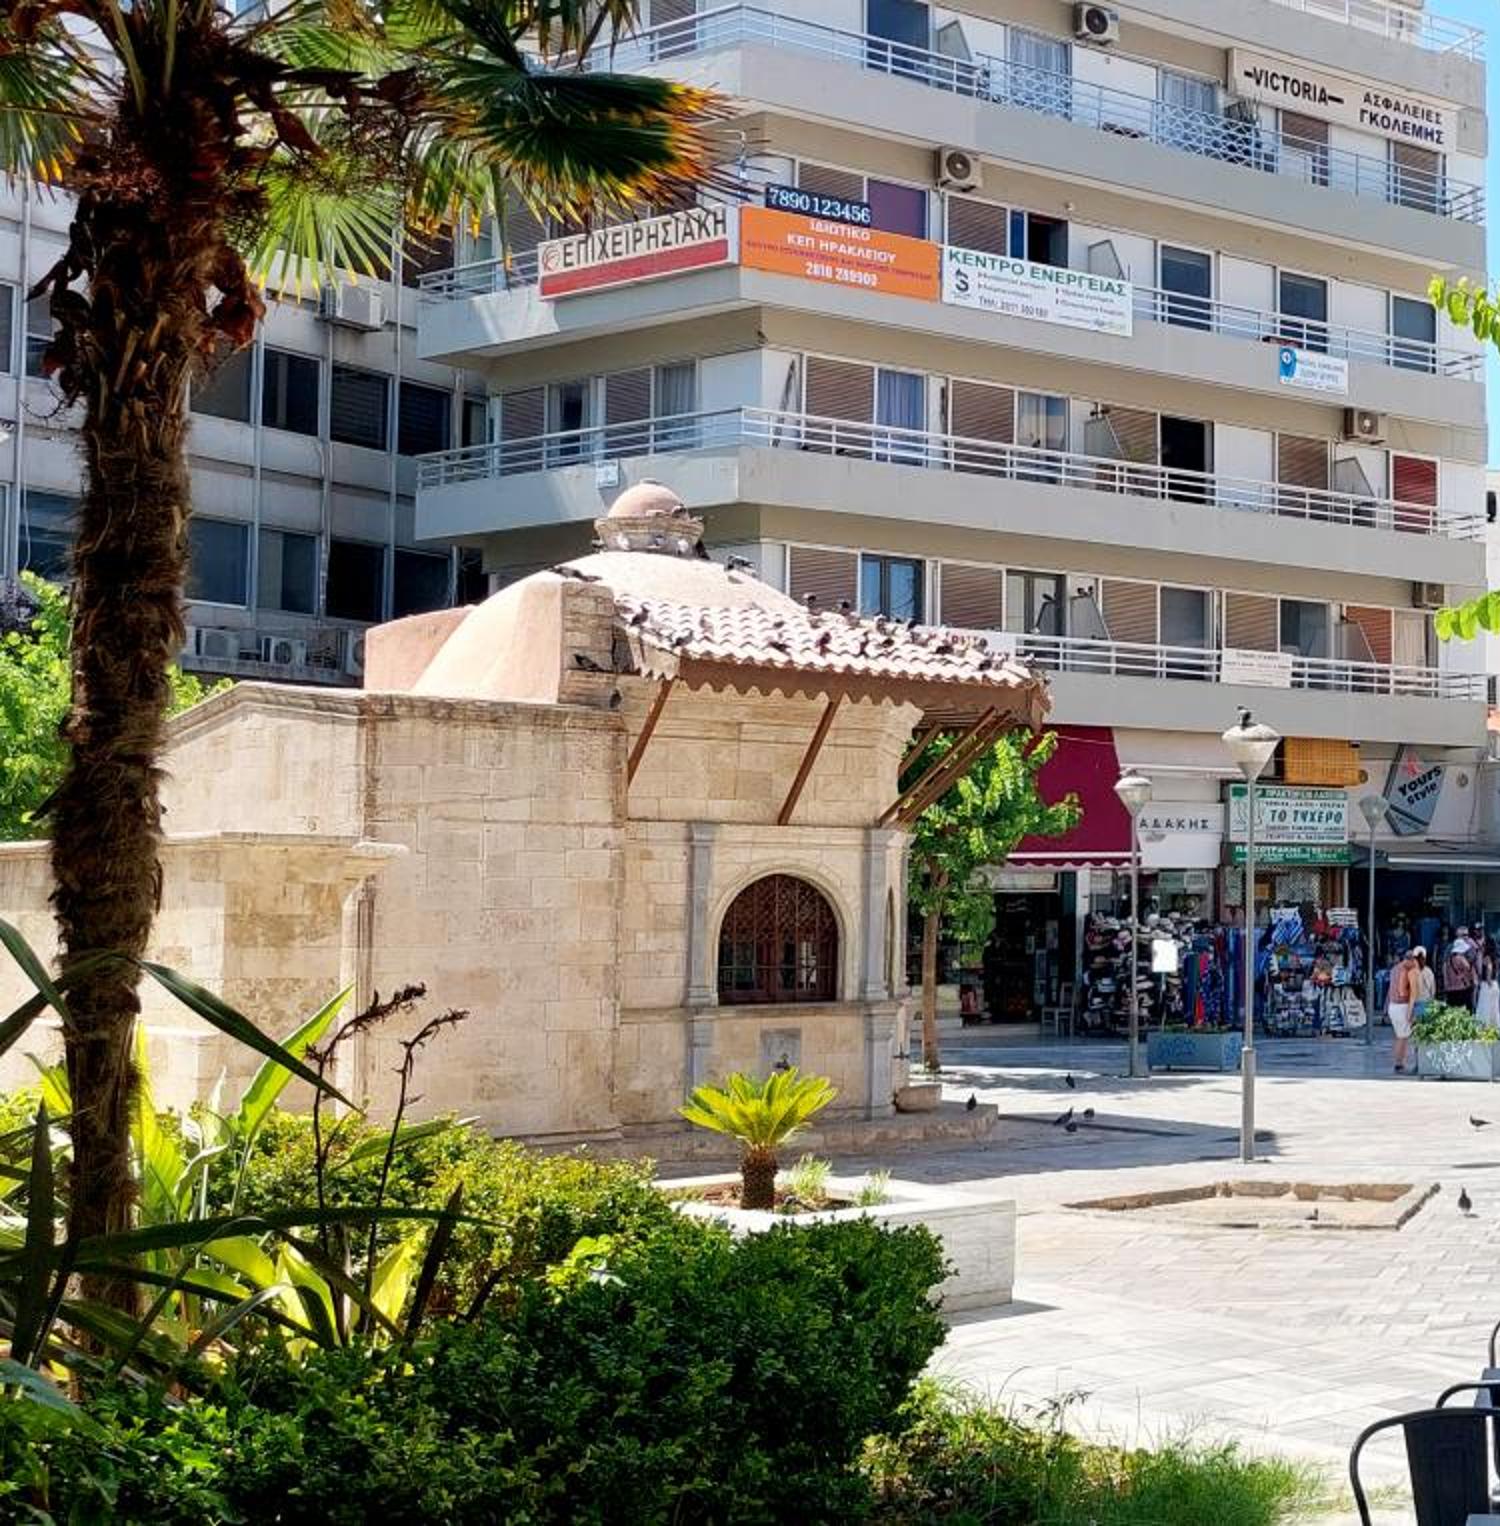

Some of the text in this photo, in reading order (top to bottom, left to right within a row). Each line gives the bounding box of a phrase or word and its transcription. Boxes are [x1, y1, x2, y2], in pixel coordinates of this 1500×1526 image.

[1363, 92, 1443, 125] ΑΣΦΑΛΕΙΕΣ
[1359, 108, 1444, 145] ΓΚΟΛΕΜΗΣ
[768, 187, 872, 224] 7890123456
[786, 233, 816, 250] ΚΕΠ
[818, 239, 897, 264] ΗΡΑΚΛΕΙΟΥ
[948, 248, 1025, 276] ΚΕΝΤΡΟ
[1029, 267, 1128, 297] ΕΝΕΡΓΕΙΑΣ
[1398, 765, 1442, 796] Yours
[1270, 809, 1343, 825] ΤΟ ΤΥΧΕΡΟ
